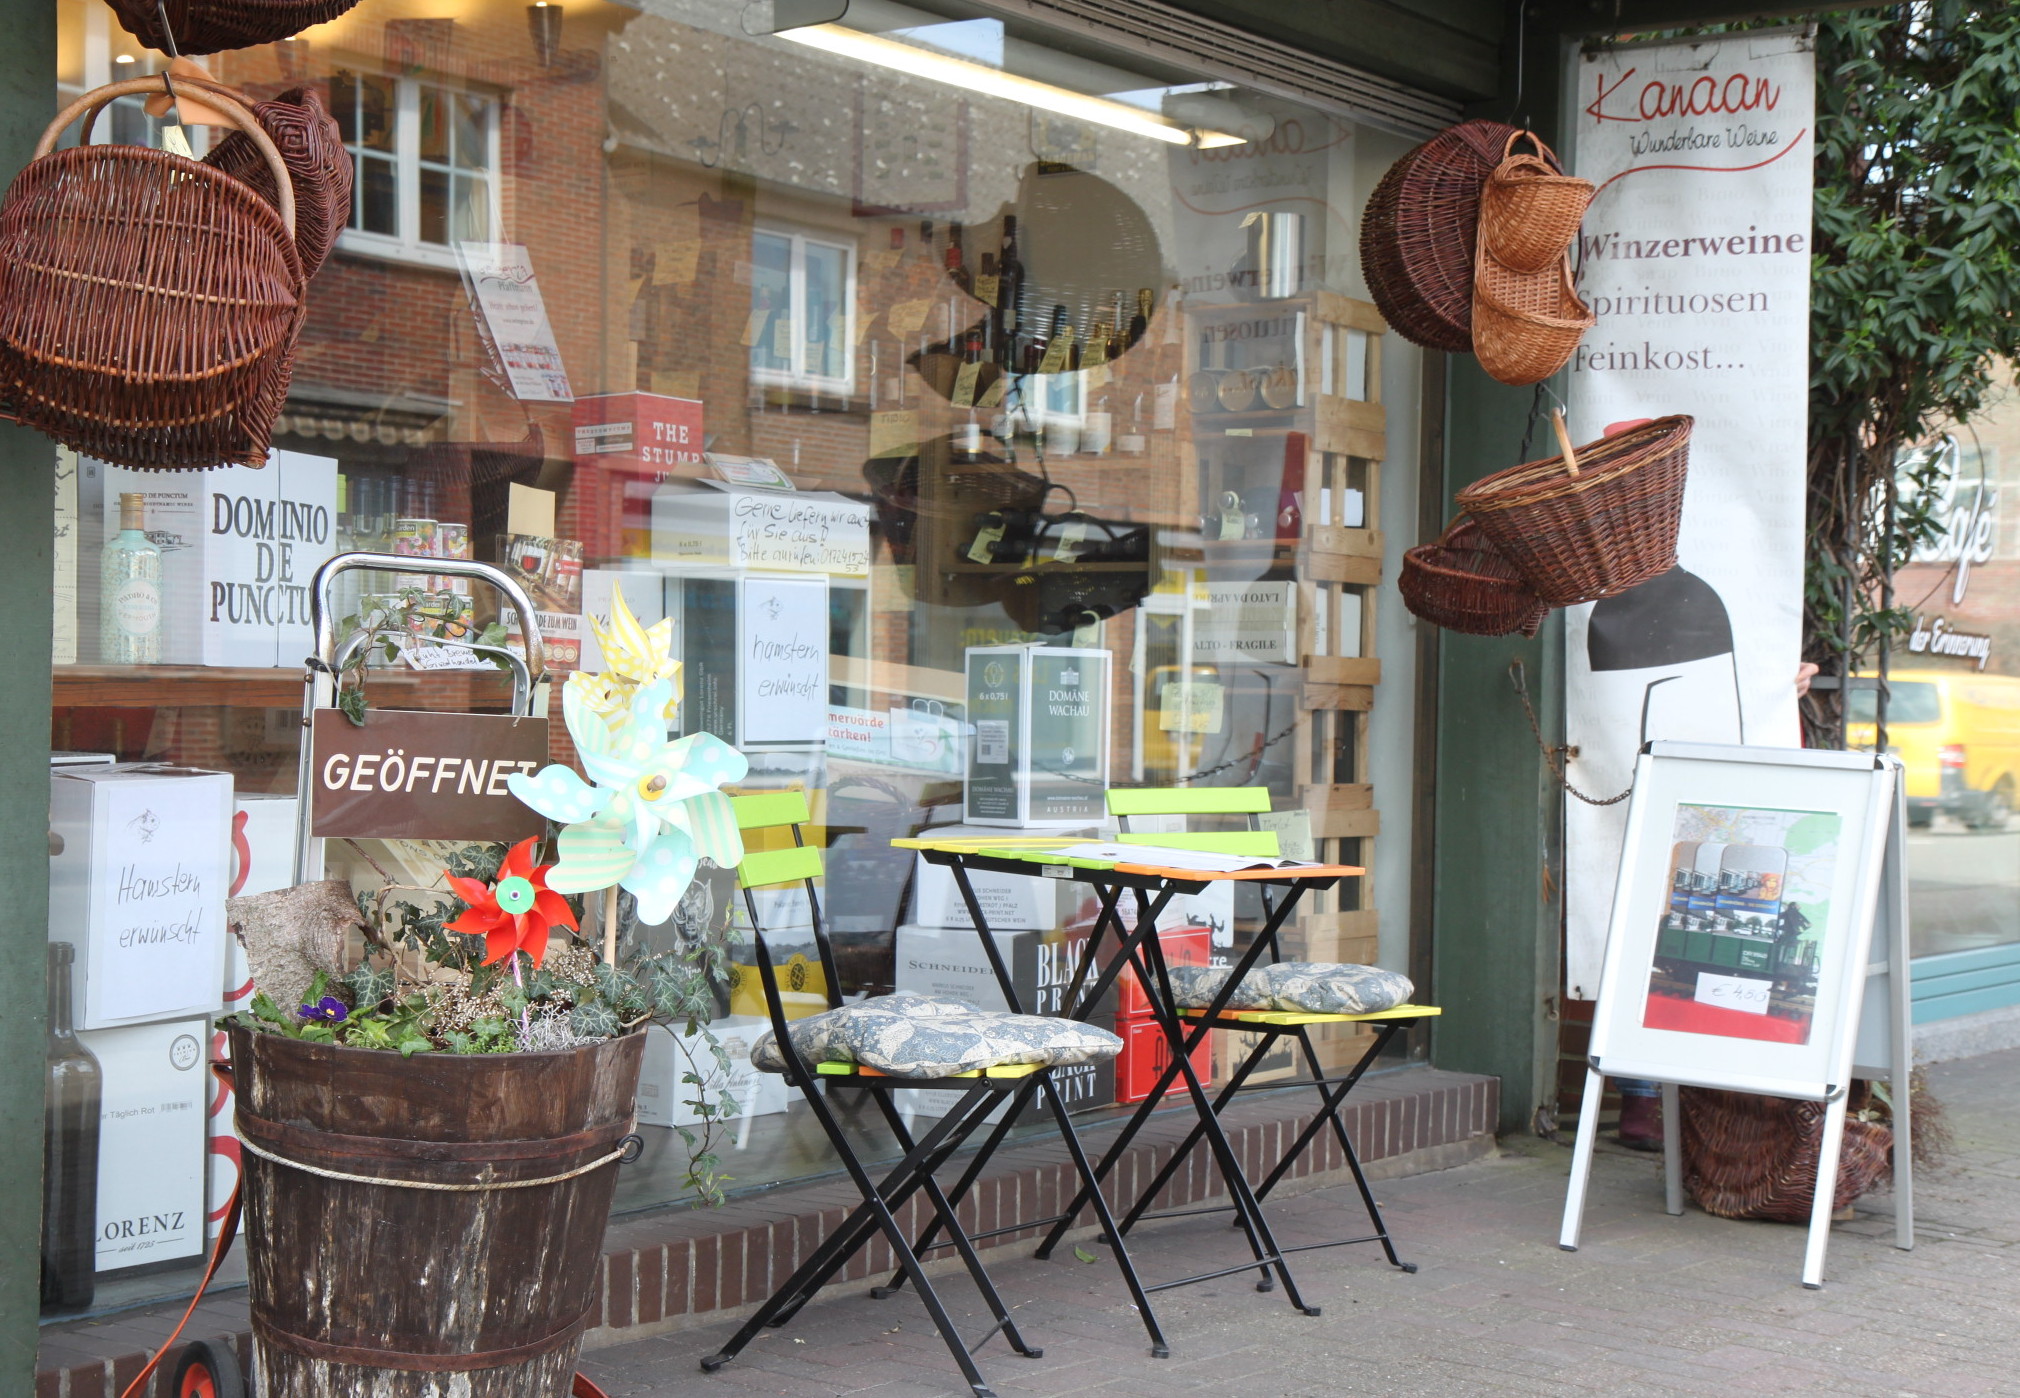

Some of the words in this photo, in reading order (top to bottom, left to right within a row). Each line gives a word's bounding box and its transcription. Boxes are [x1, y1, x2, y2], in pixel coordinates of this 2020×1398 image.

[1585, 68, 1780, 124] Kanaan
[1630, 126, 1720, 157] Wunderbare
[1726, 124, 1778, 148] Weine
[1582, 225, 1805, 261] Winzerweine
[653, 422, 689, 444] THE
[642, 446, 700, 465] STUMP
[212, 493, 329, 546] DOMINIO
[735, 497, 786, 520] Gerne
[789, 501, 827, 528] liefern
[737, 520, 760, 547] für
[764, 523, 788, 541] Sie
[255, 542, 294, 584] DE
[740, 543, 767, 562] Bitte
[210, 581, 331, 627] PUNCTU
[547, 614, 561, 628] ZUM
[562, 615, 577, 630] WEIN
[1230, 640, 1277, 650] FRAGILE
[758, 672, 819, 701] erwünscht
[979, 692, 984, 700] 6
[1049, 689, 1089, 702] DOMÄNE
[1049, 704, 1090, 717] WACHAU
[119, 907, 203, 948] erwünscht
[110, 1108, 138, 1119] Täglich
[141, 1106, 155, 1115] Rot
